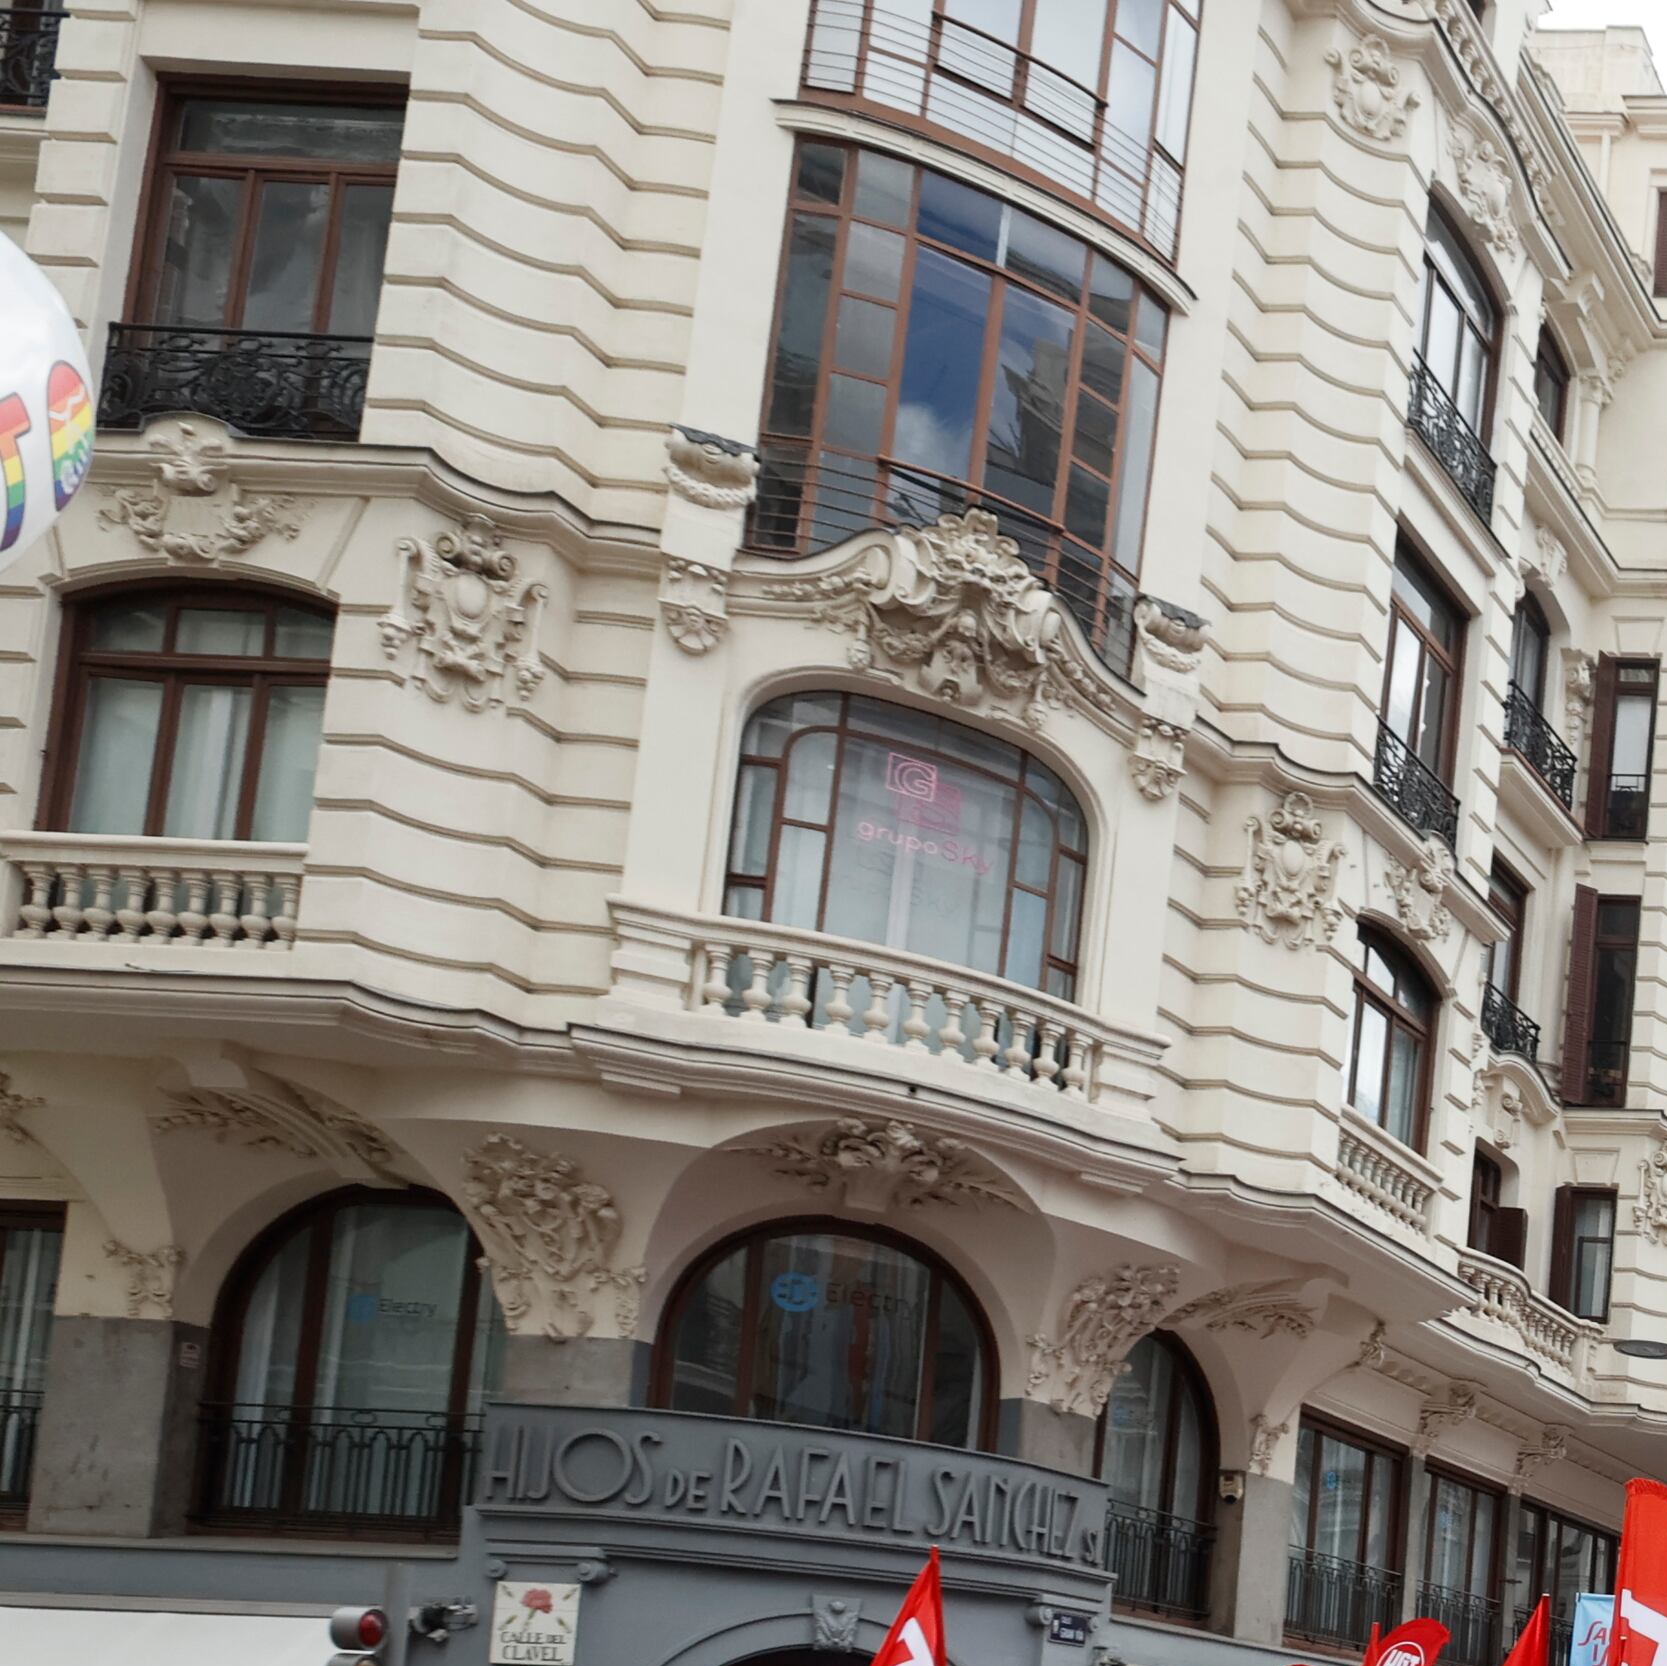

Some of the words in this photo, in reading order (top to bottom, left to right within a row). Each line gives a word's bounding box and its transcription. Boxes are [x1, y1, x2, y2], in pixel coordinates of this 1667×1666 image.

[483, 1425, 663, 1504] HIJOS
[665, 1470, 711, 1511] DE
[719, 1437, 914, 1533] RAFAEL
[501, 1631, 543, 1644] CALLE
[502, 1645, 563, 1661] CLAVEL
